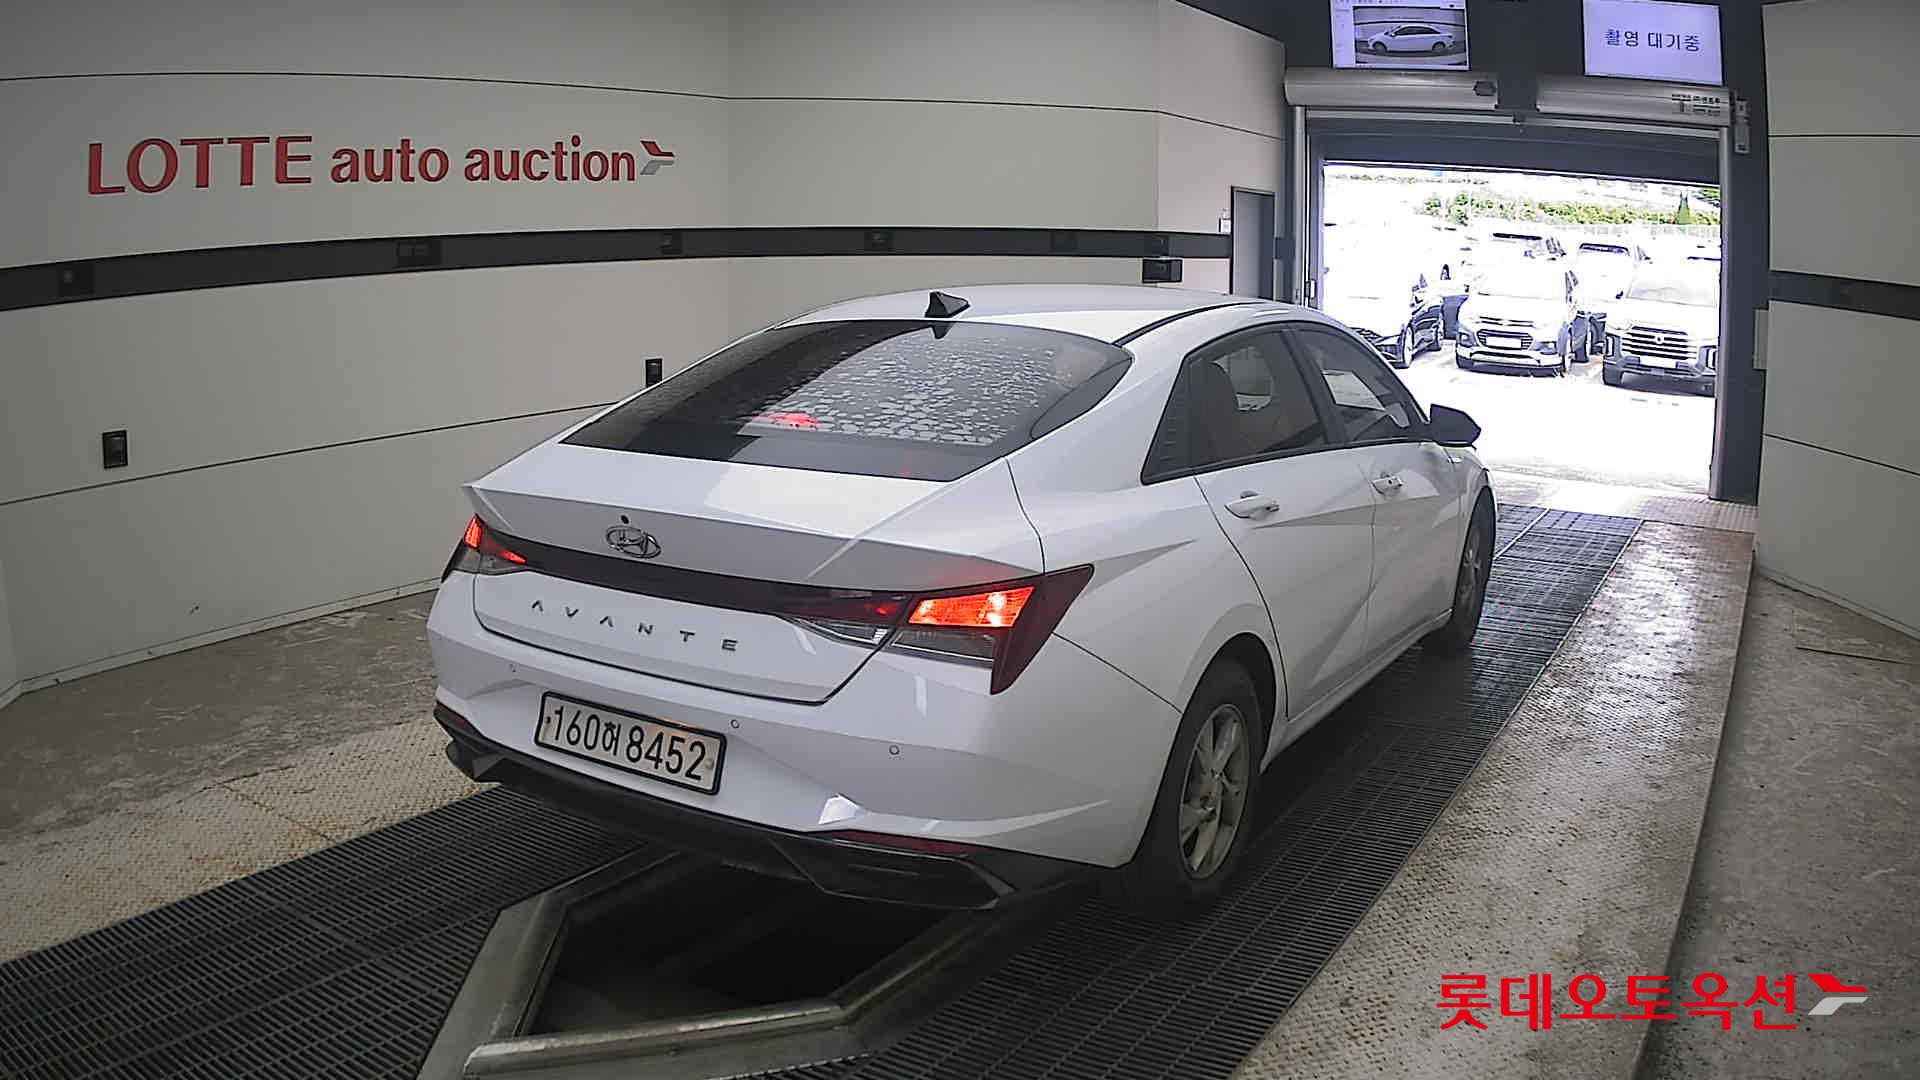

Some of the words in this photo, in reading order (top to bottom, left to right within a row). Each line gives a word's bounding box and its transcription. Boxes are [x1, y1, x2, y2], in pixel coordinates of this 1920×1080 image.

[1605, 29, 1639, 47] 촬영
[1647, 32, 1701, 52] 대기중
[87, 135, 313, 195] LOTTE
[330, 138, 449, 183] auto
[464, 134, 636, 182] auction
[531, 599, 738, 652] AVANTE
